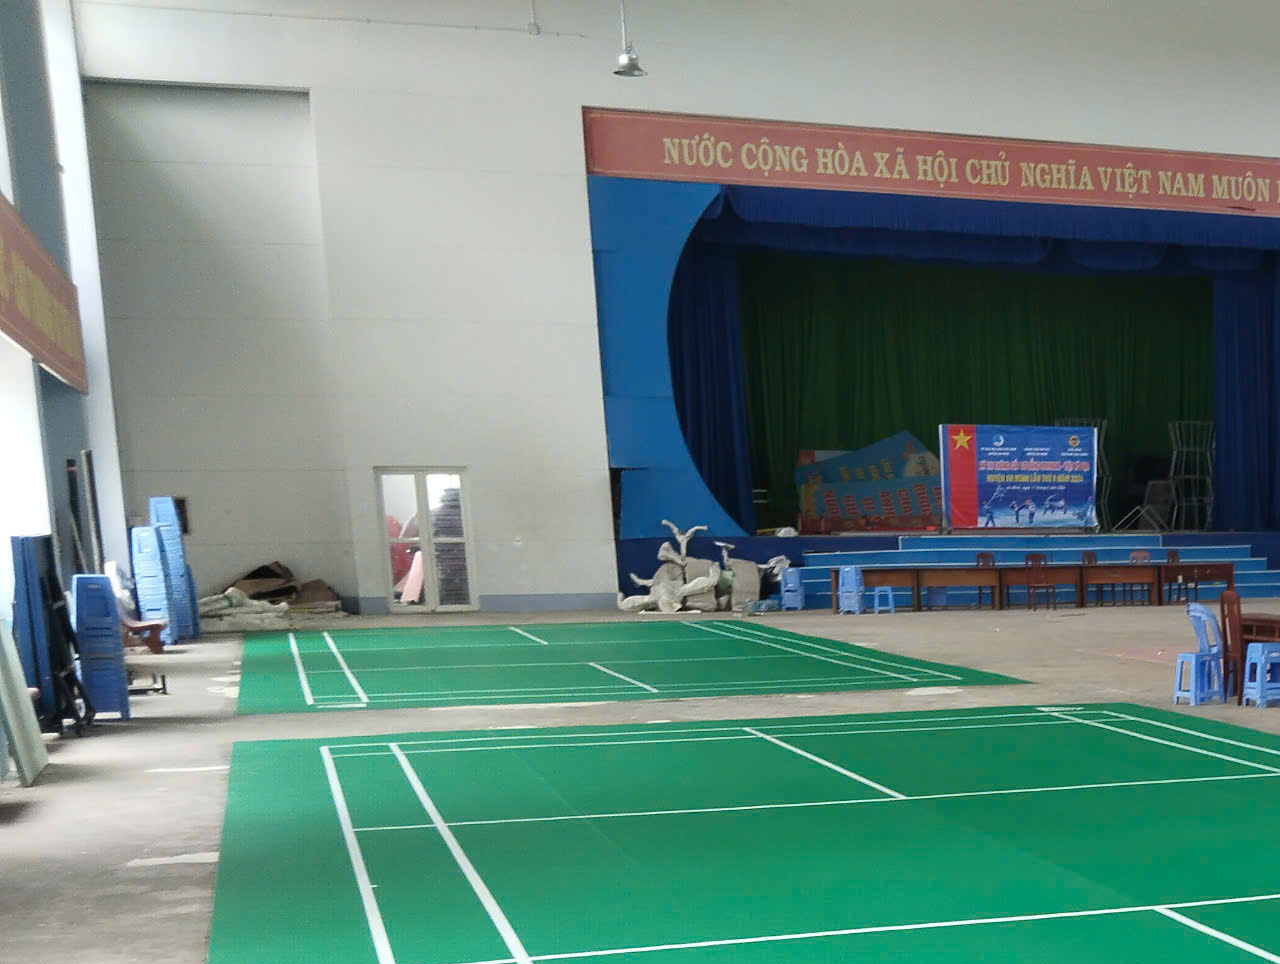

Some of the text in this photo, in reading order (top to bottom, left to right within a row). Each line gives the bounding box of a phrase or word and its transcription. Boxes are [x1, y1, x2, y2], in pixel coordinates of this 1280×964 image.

[663, 133, 733, 168] NƯỚC
[741, 137, 808, 176] CỘNG
[816, 142, 868, 176] HÒA
[874, 147, 910, 180] XÃ
[917, 150, 958, 188] HỘI
[966, 151, 1010, 186] CHỦ
[1020, 159, 1095, 190] NGHĨA
[1097, 161, 1151, 199] VIỆT
[1158, 169, 1205, 198] NAM
[1212, 171, 1270, 202] MUÔN
